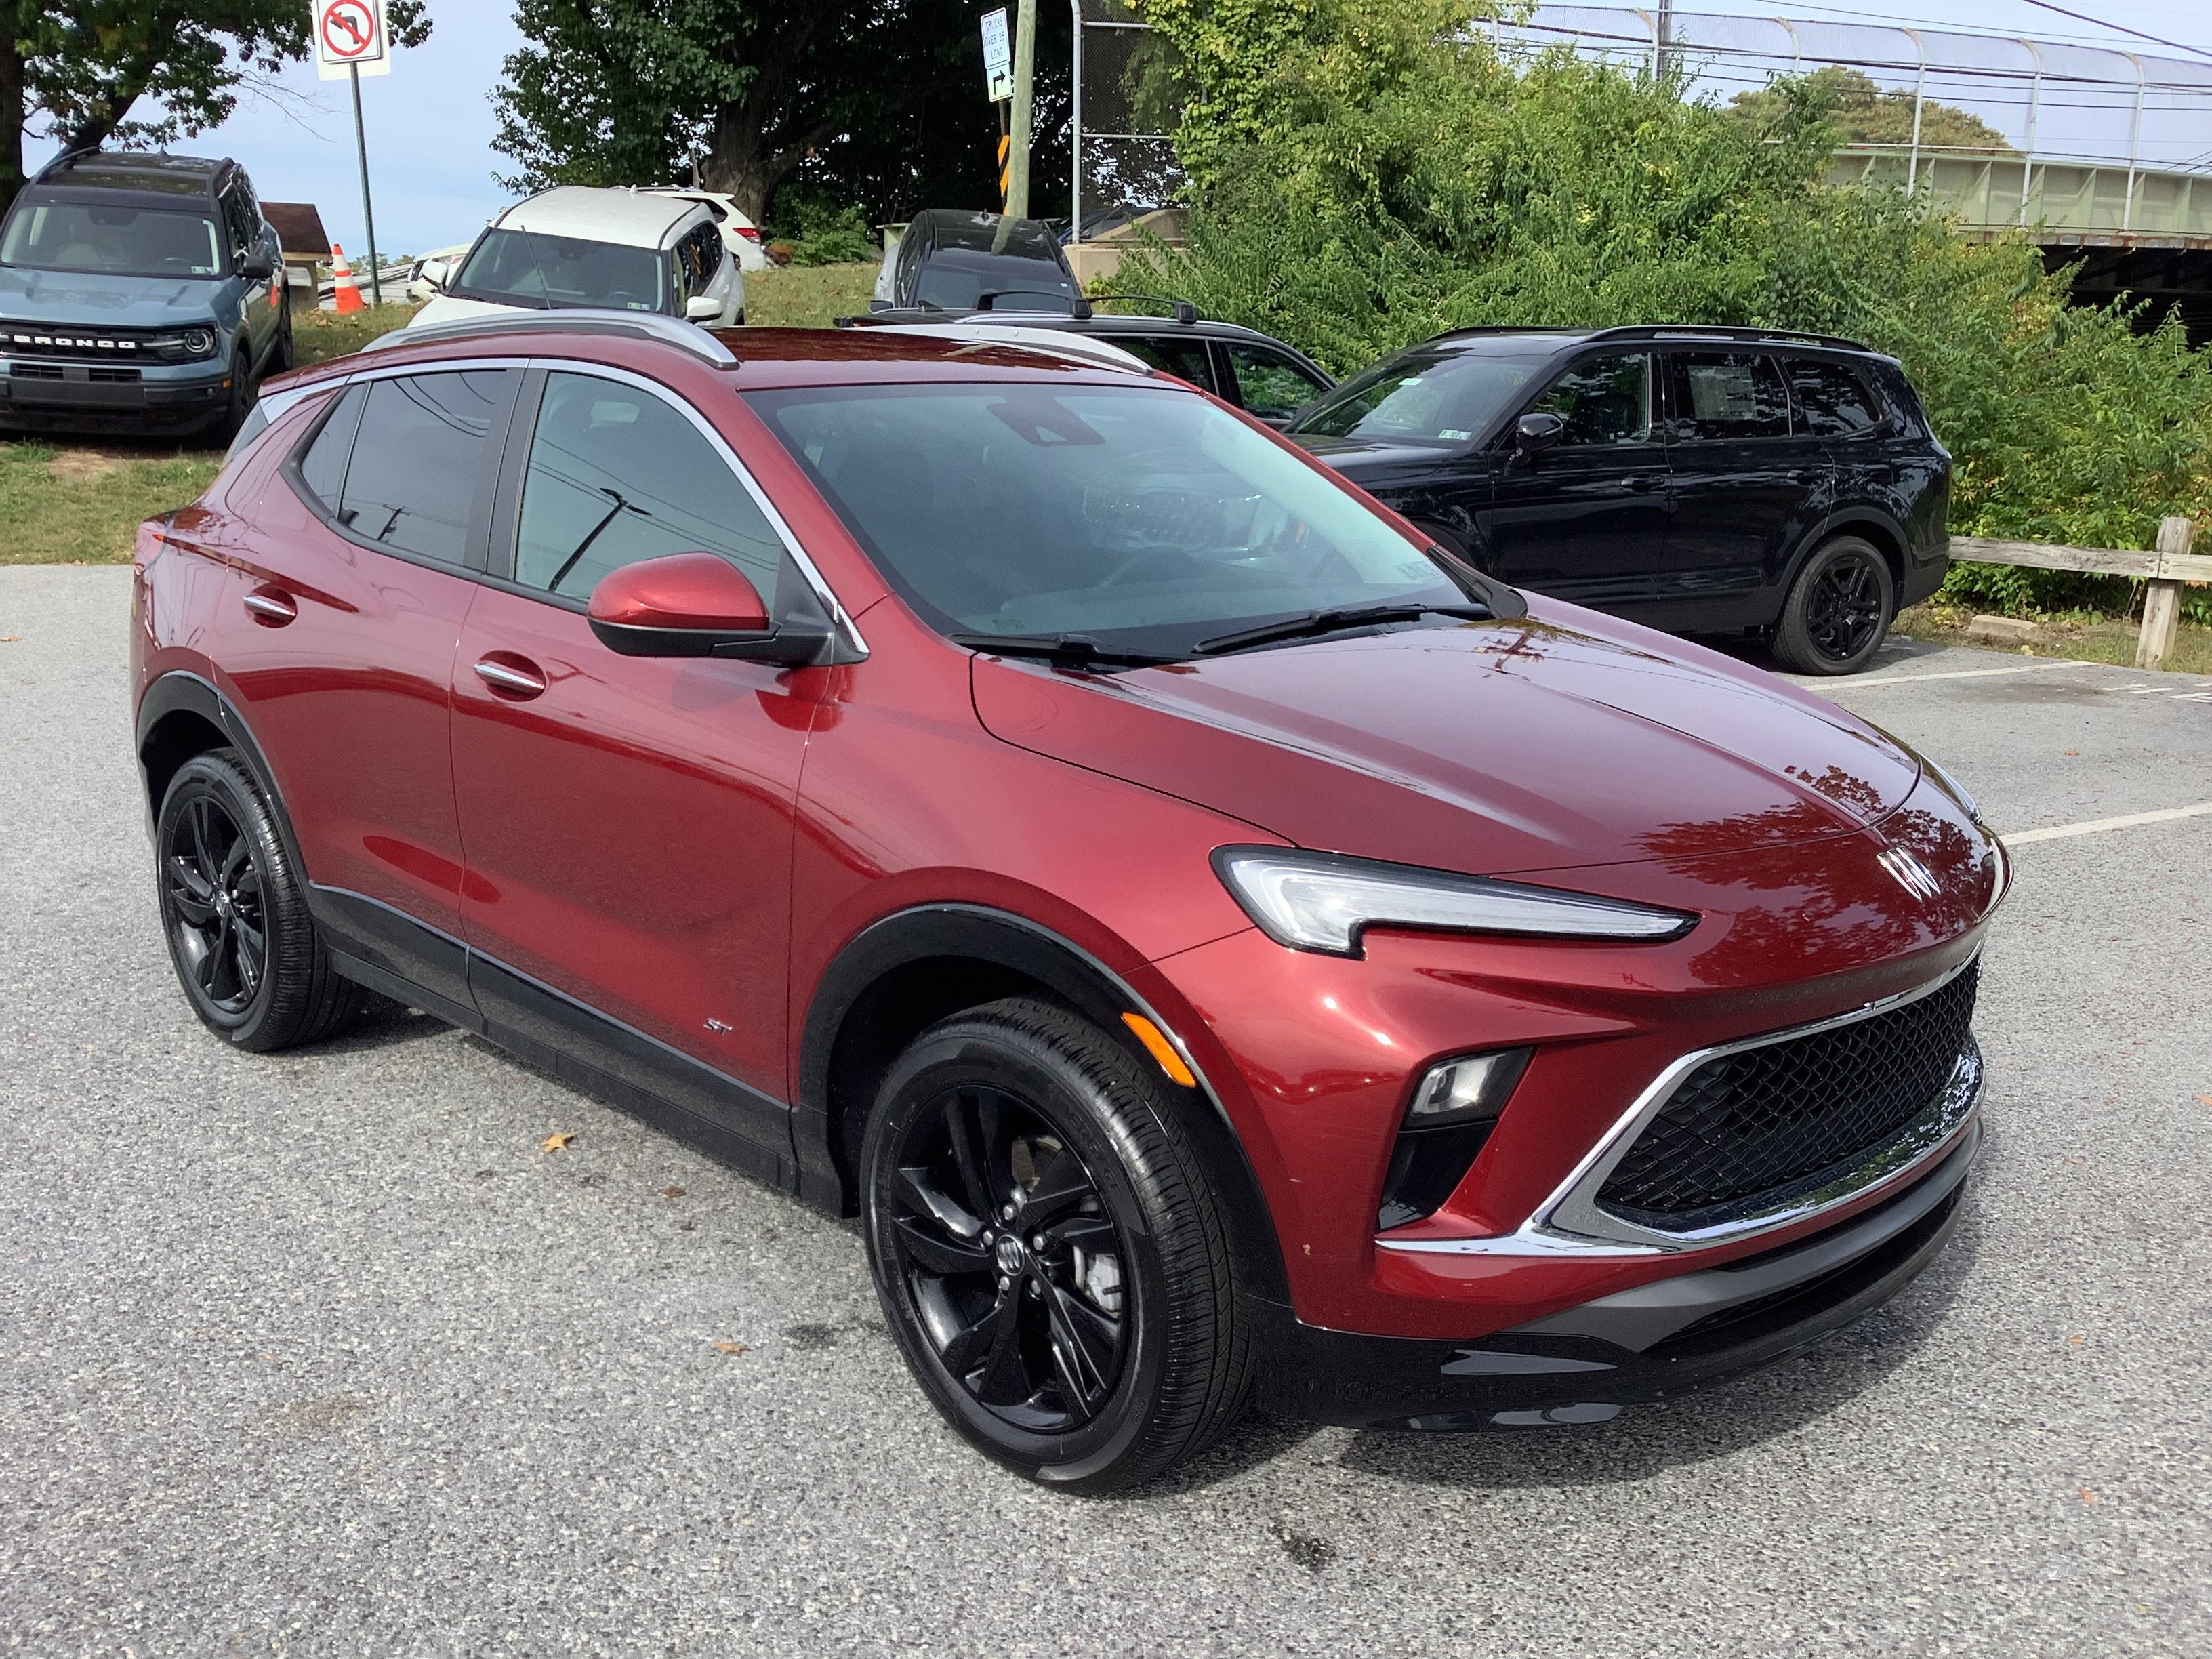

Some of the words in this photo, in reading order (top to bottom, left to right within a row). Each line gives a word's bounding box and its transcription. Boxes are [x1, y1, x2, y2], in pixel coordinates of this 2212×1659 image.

[985, 16, 1003, 30] TRUCKS
[985, 34, 998, 46] OVER
[991, 47, 1003, 60] LONG
[14, 335, 136, 349] BRONCO
